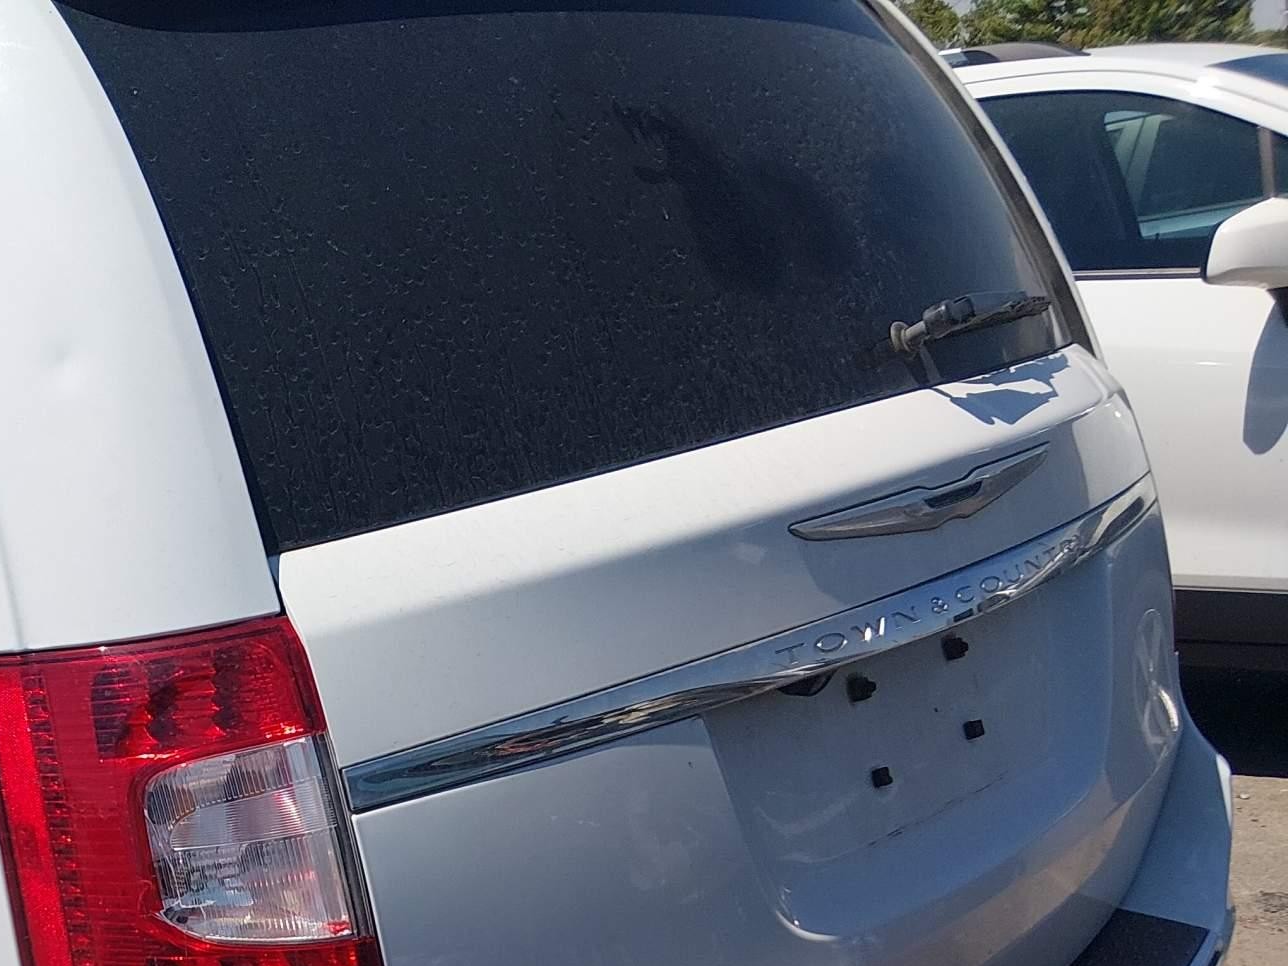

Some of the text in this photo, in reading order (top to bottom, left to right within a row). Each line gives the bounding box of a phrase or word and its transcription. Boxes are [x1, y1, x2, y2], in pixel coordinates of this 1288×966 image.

[774, 534, 1082, 665] TOWN & COUNTR
